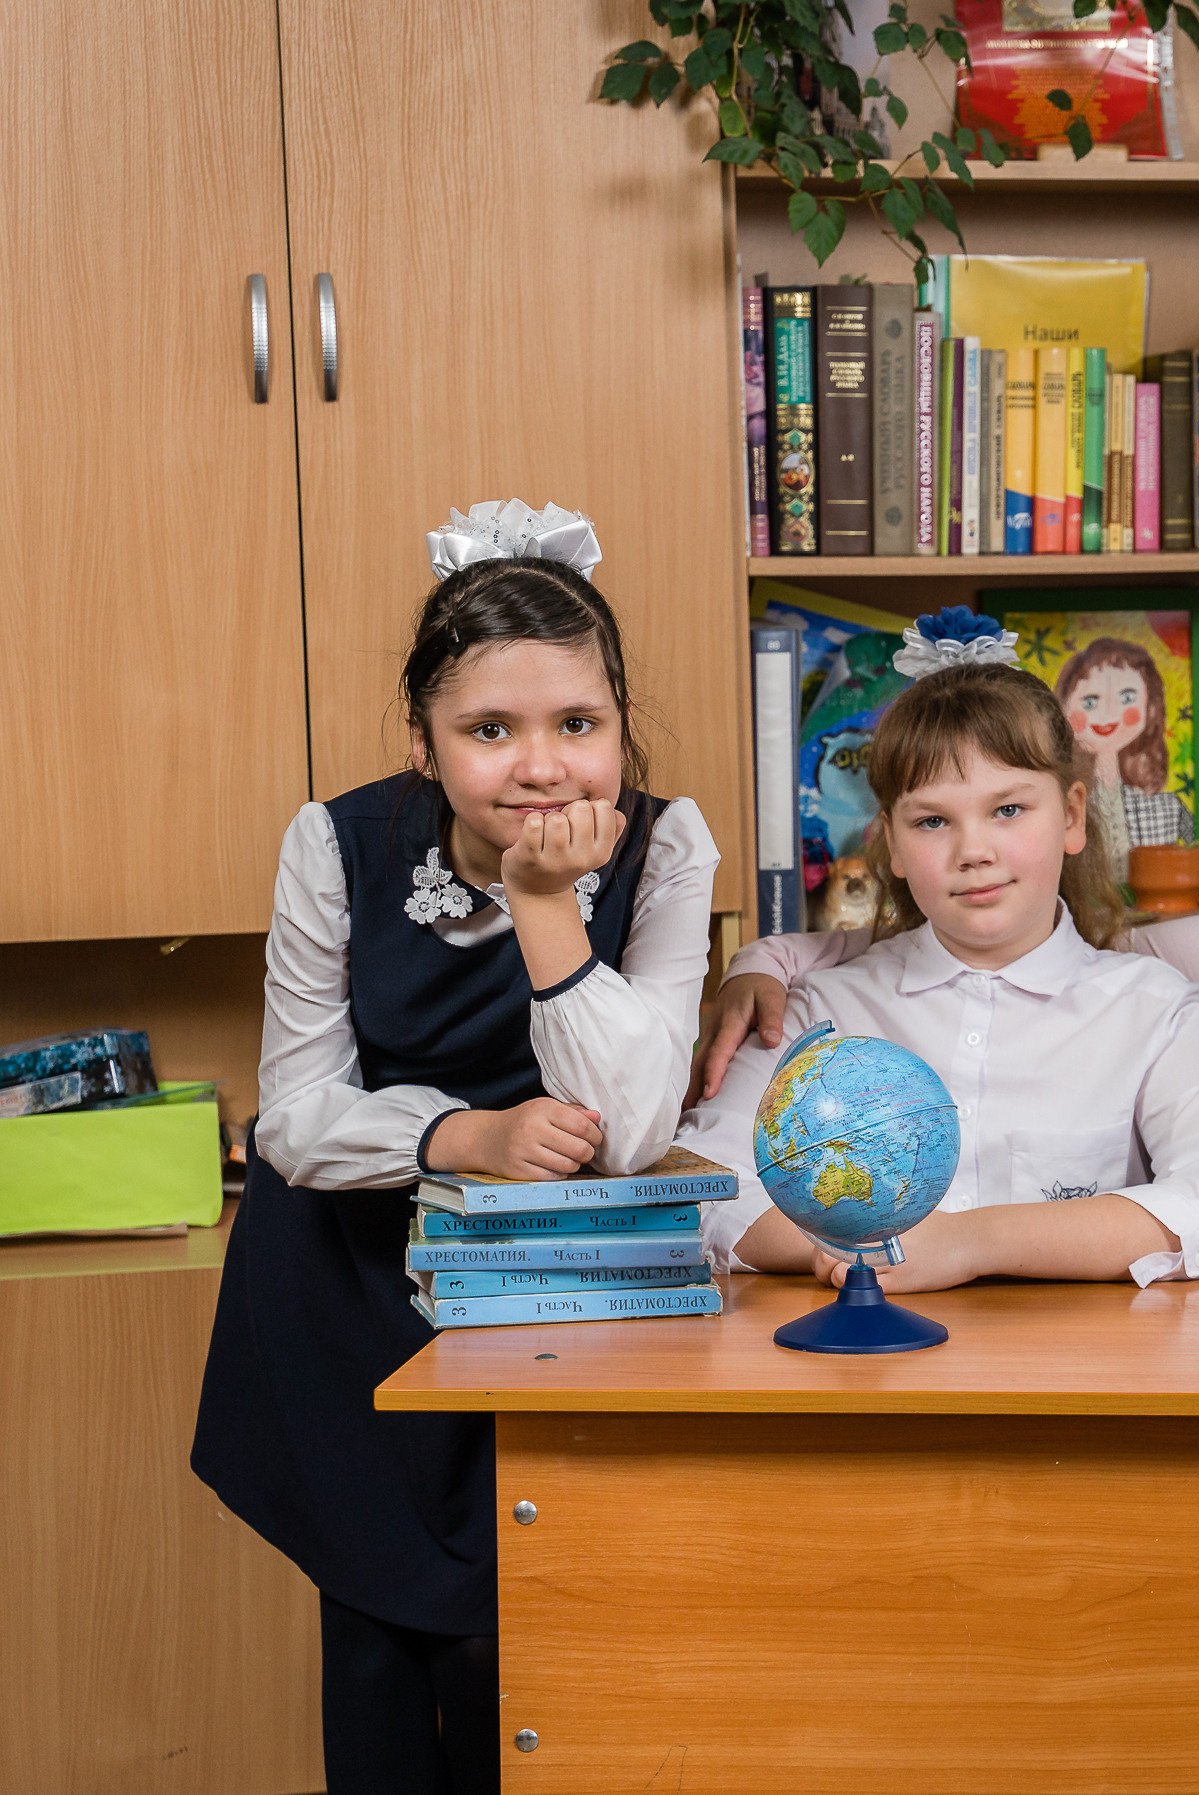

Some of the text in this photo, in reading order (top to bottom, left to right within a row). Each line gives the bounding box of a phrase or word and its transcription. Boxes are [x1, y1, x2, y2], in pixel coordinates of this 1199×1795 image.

[1023, 324, 1079, 341] Наши
[880, 350, 891, 417] СЛОВАРЬ
[918, 326, 933, 542] ПОСЛОВИЦЫ РУССКОГО НАРОДА
[630, 1180, 728, 1197] ХРЕСТОМАТИЯ.
[442, 1218, 562, 1232] ХРЕСТОМАТИЯ.
[425, 1250, 531, 1263] ХРЕСТОМАТИЯ.
[575, 1267, 692, 1283] ХРЕСТОМАТИЯ.
[605, 1295, 707, 1311] ХРЕСТОМАТИЯ.
